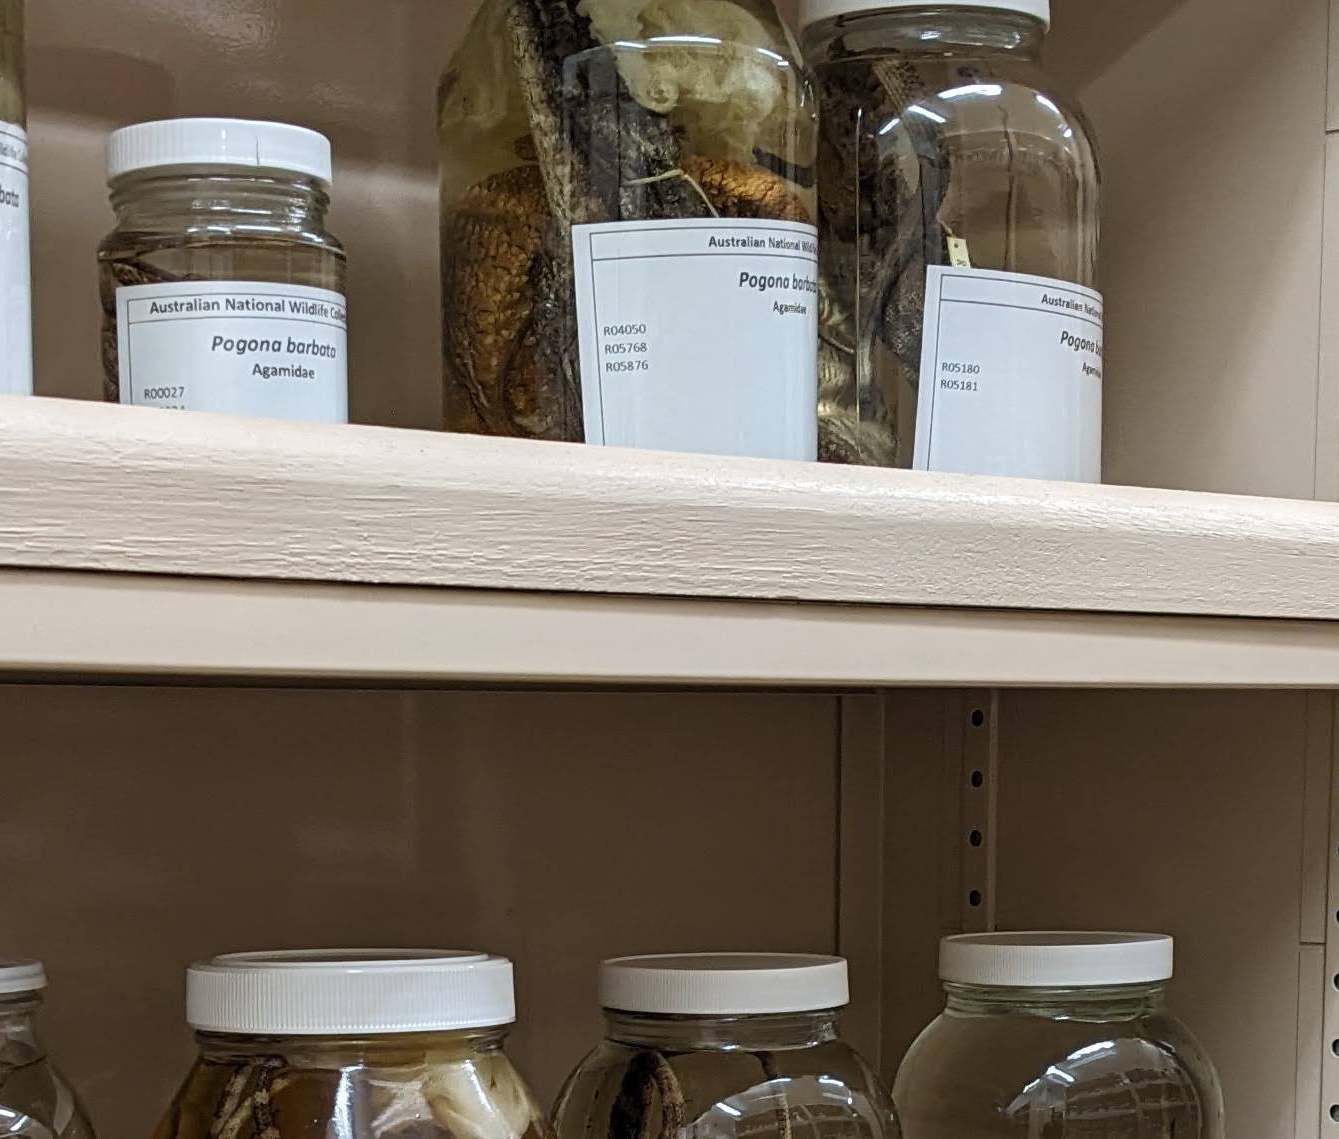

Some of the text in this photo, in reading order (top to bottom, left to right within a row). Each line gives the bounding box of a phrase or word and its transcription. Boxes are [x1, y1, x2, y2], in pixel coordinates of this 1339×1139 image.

[709, 236, 766, 249] Australian
[769, 237, 799, 250] National
[739, 272, 789, 291] Pogona
[150, 298, 328, 317] Australian National Wildlife
[773, 301, 806, 315] Agamidae
[1041, 294, 1082, 311] Australian
[604, 324, 646, 336] R04050
[211, 336, 336, 358] Pogona barbata
[1061, 331, 1094, 351] Pogona
[605, 343, 647, 354] R05768
[252, 363, 315, 379] Agamidae
[606, 360, 648, 372] R05876
[942, 363, 980, 373] R05180
[941, 380, 977, 391] R05181
[144, 387, 185, 400] R00027
